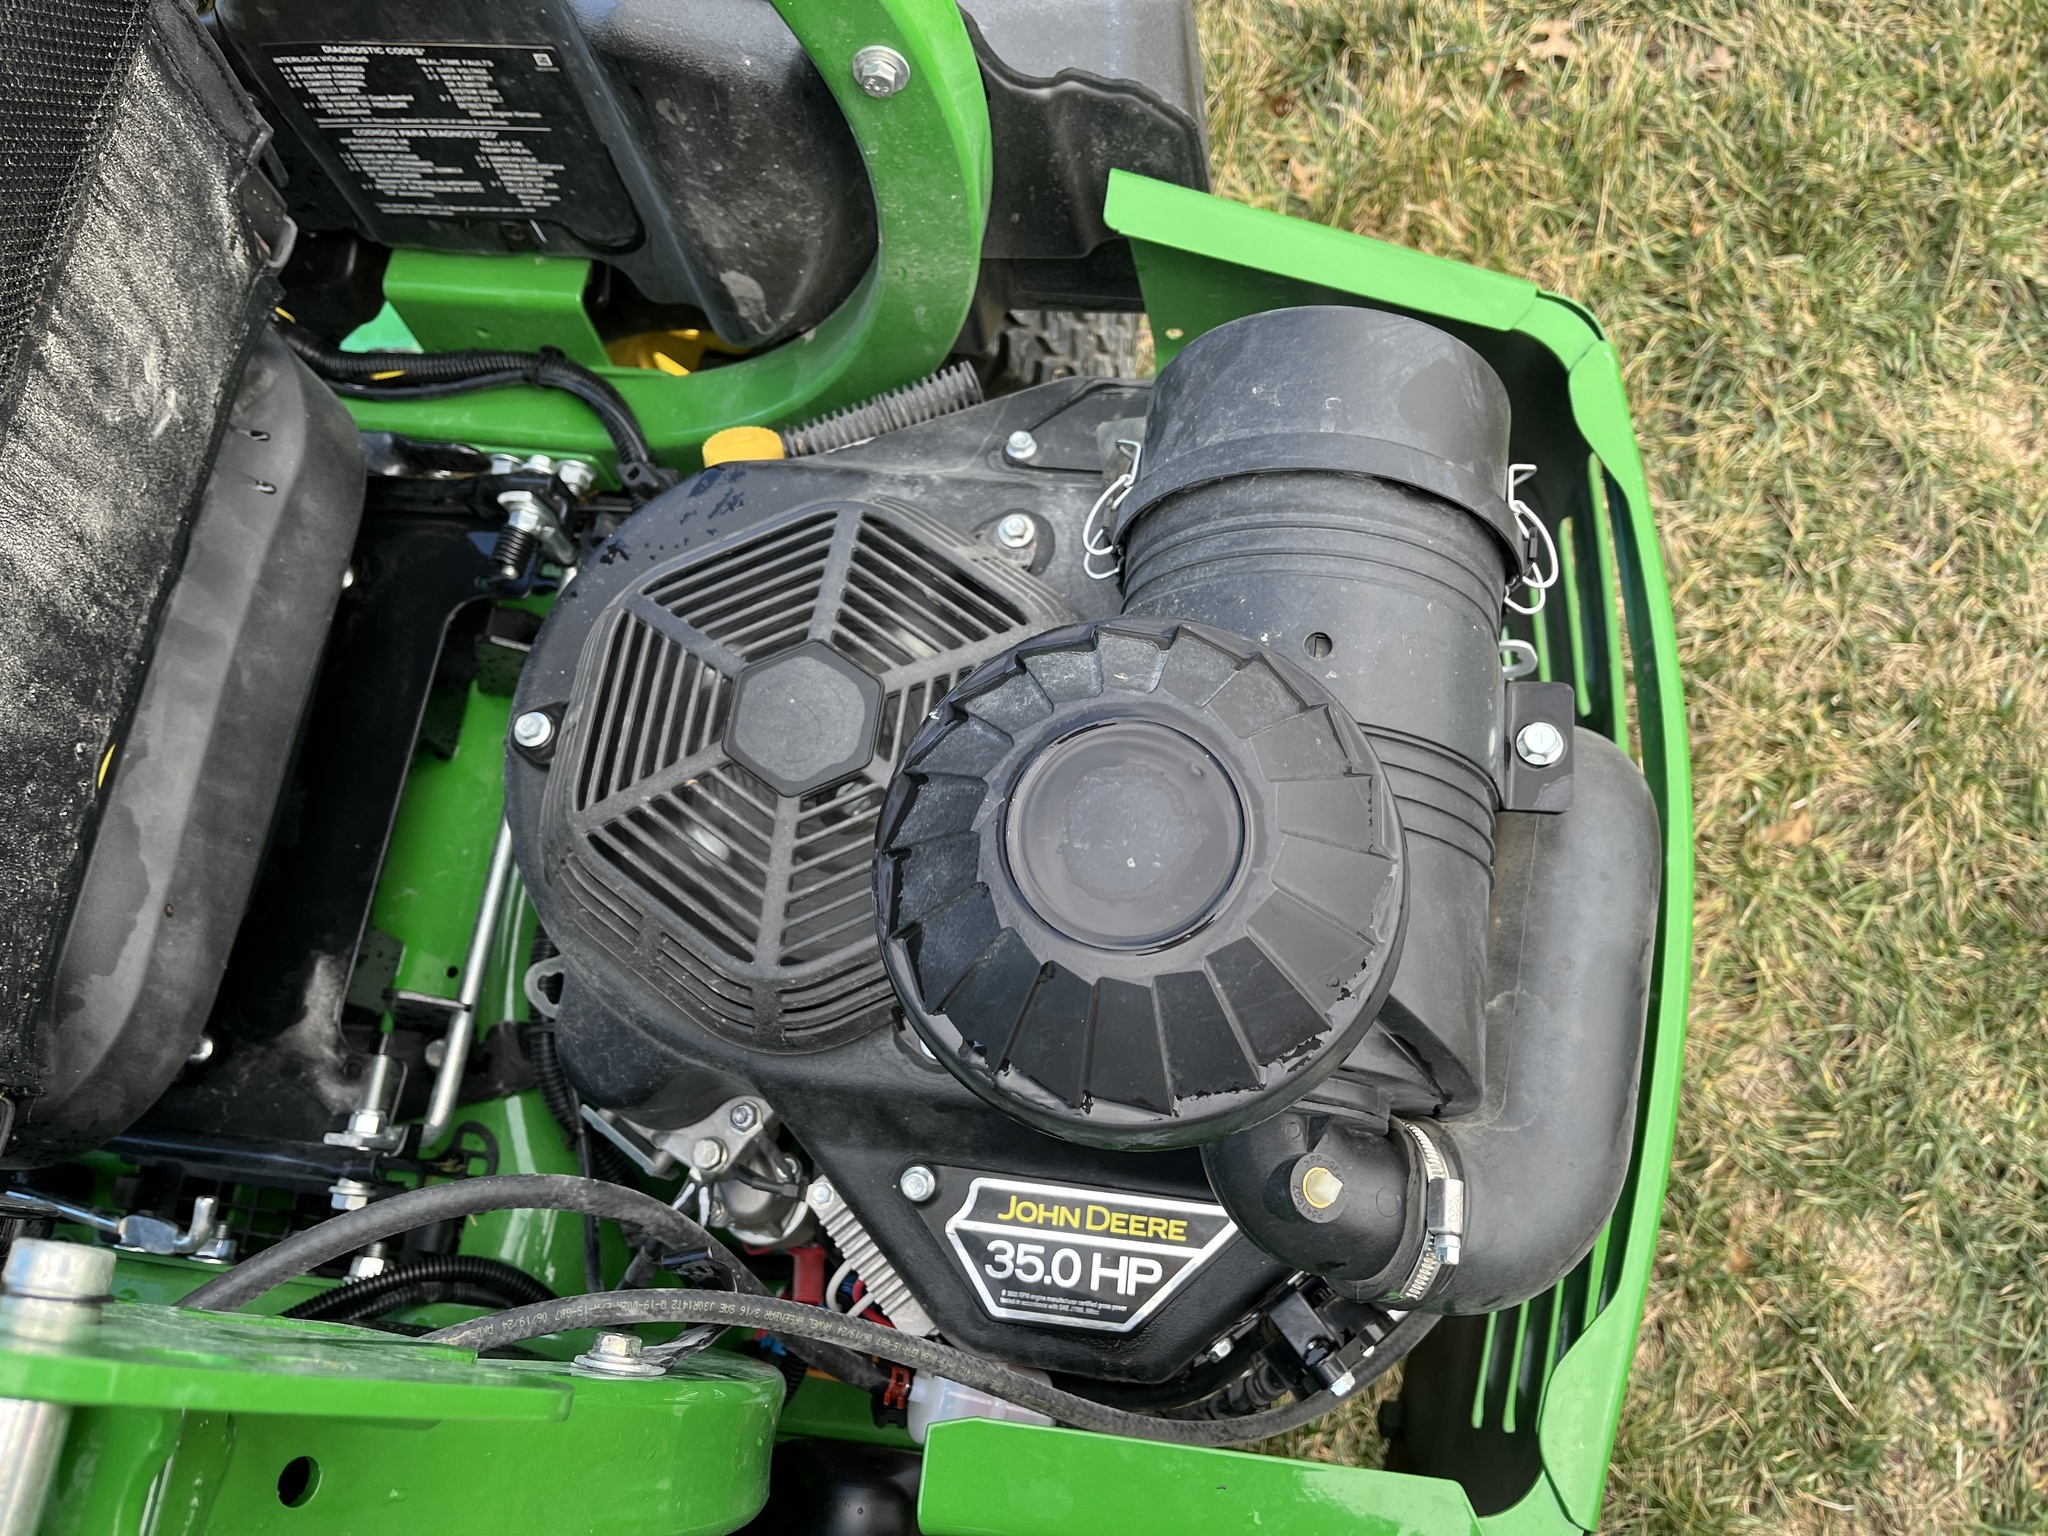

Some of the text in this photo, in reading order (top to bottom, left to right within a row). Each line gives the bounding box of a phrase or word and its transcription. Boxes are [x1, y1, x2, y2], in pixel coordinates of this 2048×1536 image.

[321, 45, 385, 55] DIAGNOSTIC
[272, 55, 321, 64] INTERLOCK
[997, 1195, 1188, 1242] JOHN DEERE
[984, 1239, 1163, 1296] 35.0 HP
[718, 1302, 736, 1315] SAE
[739, 1305, 761, 1319] 3/16
[502, 1311, 548, 1330] 06/19/24
[764, 1309, 805, 1326] GREENBAR
[809, 1317, 833, 1331] AKWEL
[837, 1326, 873, 1343] 06/19/24
